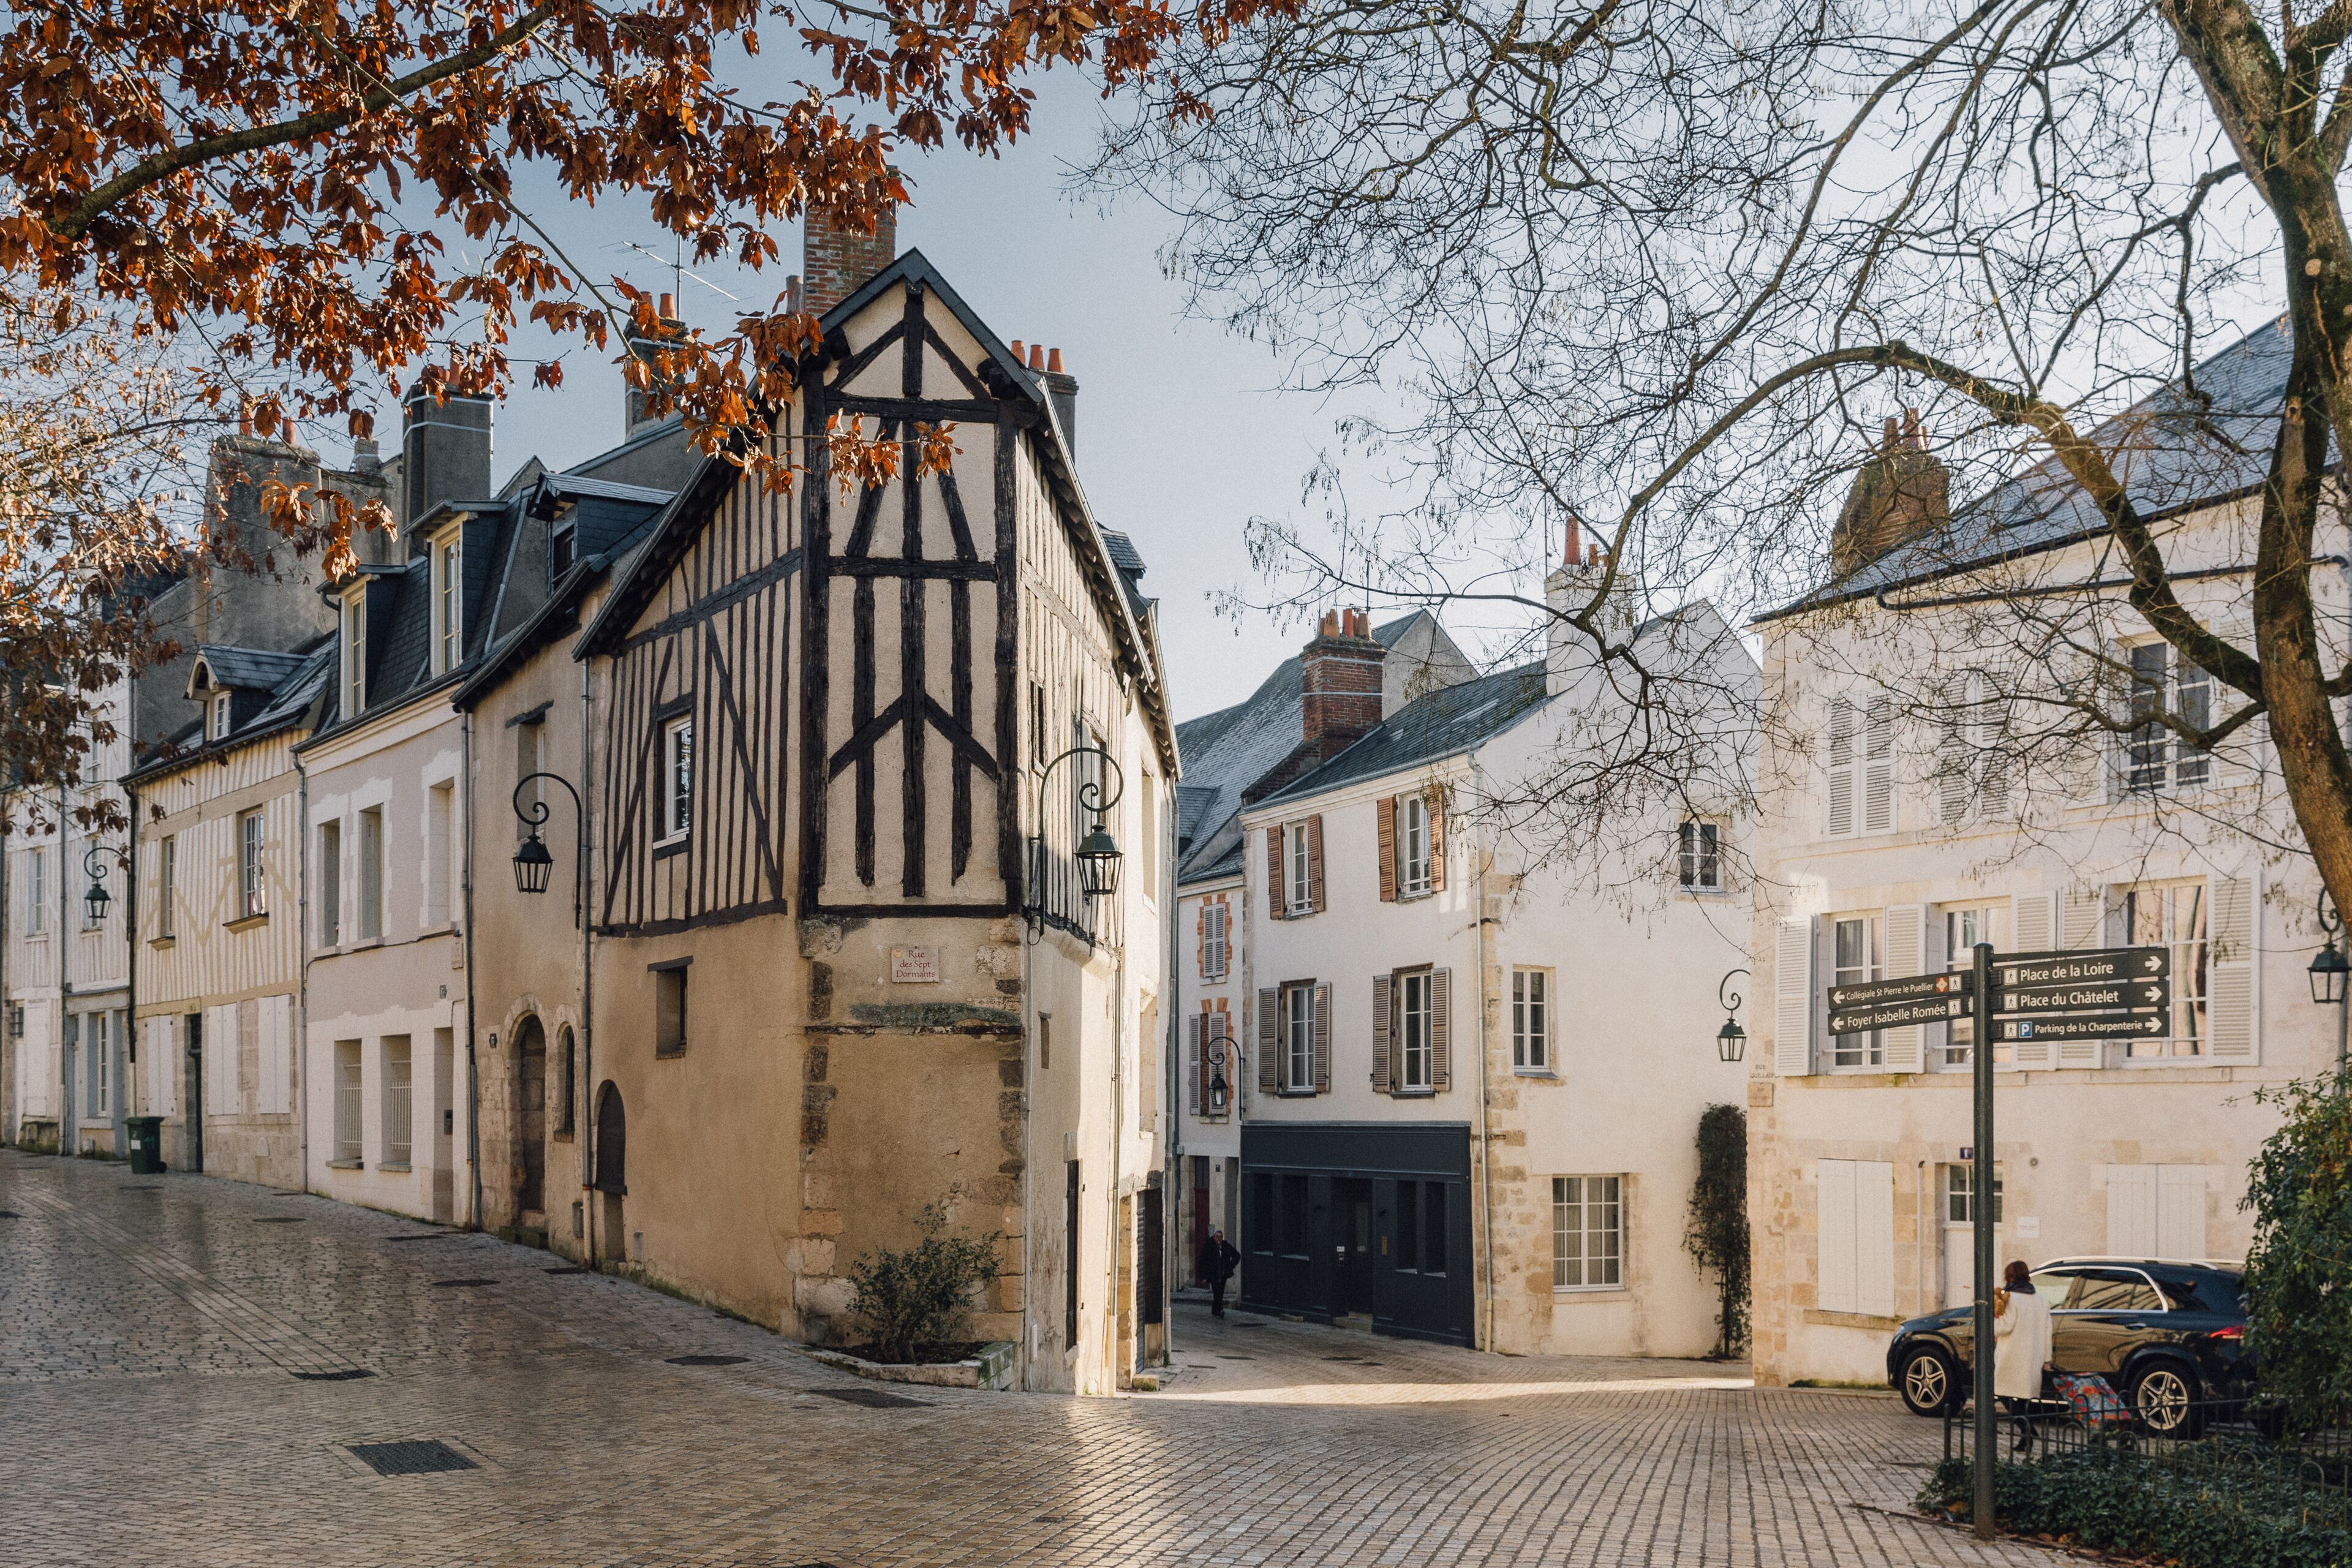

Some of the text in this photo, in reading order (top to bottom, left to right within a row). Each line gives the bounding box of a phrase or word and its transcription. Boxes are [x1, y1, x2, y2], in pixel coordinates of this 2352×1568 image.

[908, 950, 925, 959] Rue
[914, 960, 931, 971] Sept
[2021, 962, 2114, 981] Place de la Loire
[1846, 989, 1875, 1000] Collégiale
[1876, 988, 1883, 997] St
[1883, 987, 1902, 995] Pierre
[1910, 982, 1934, 992] Puellier
[2021, 990, 2119, 1007] Place du Châtelet
[1847, 1003, 1946, 1028] Foyer Isabelle Romée
[2021, 1020, 2143, 1036] P Parking de la Charpenterie
